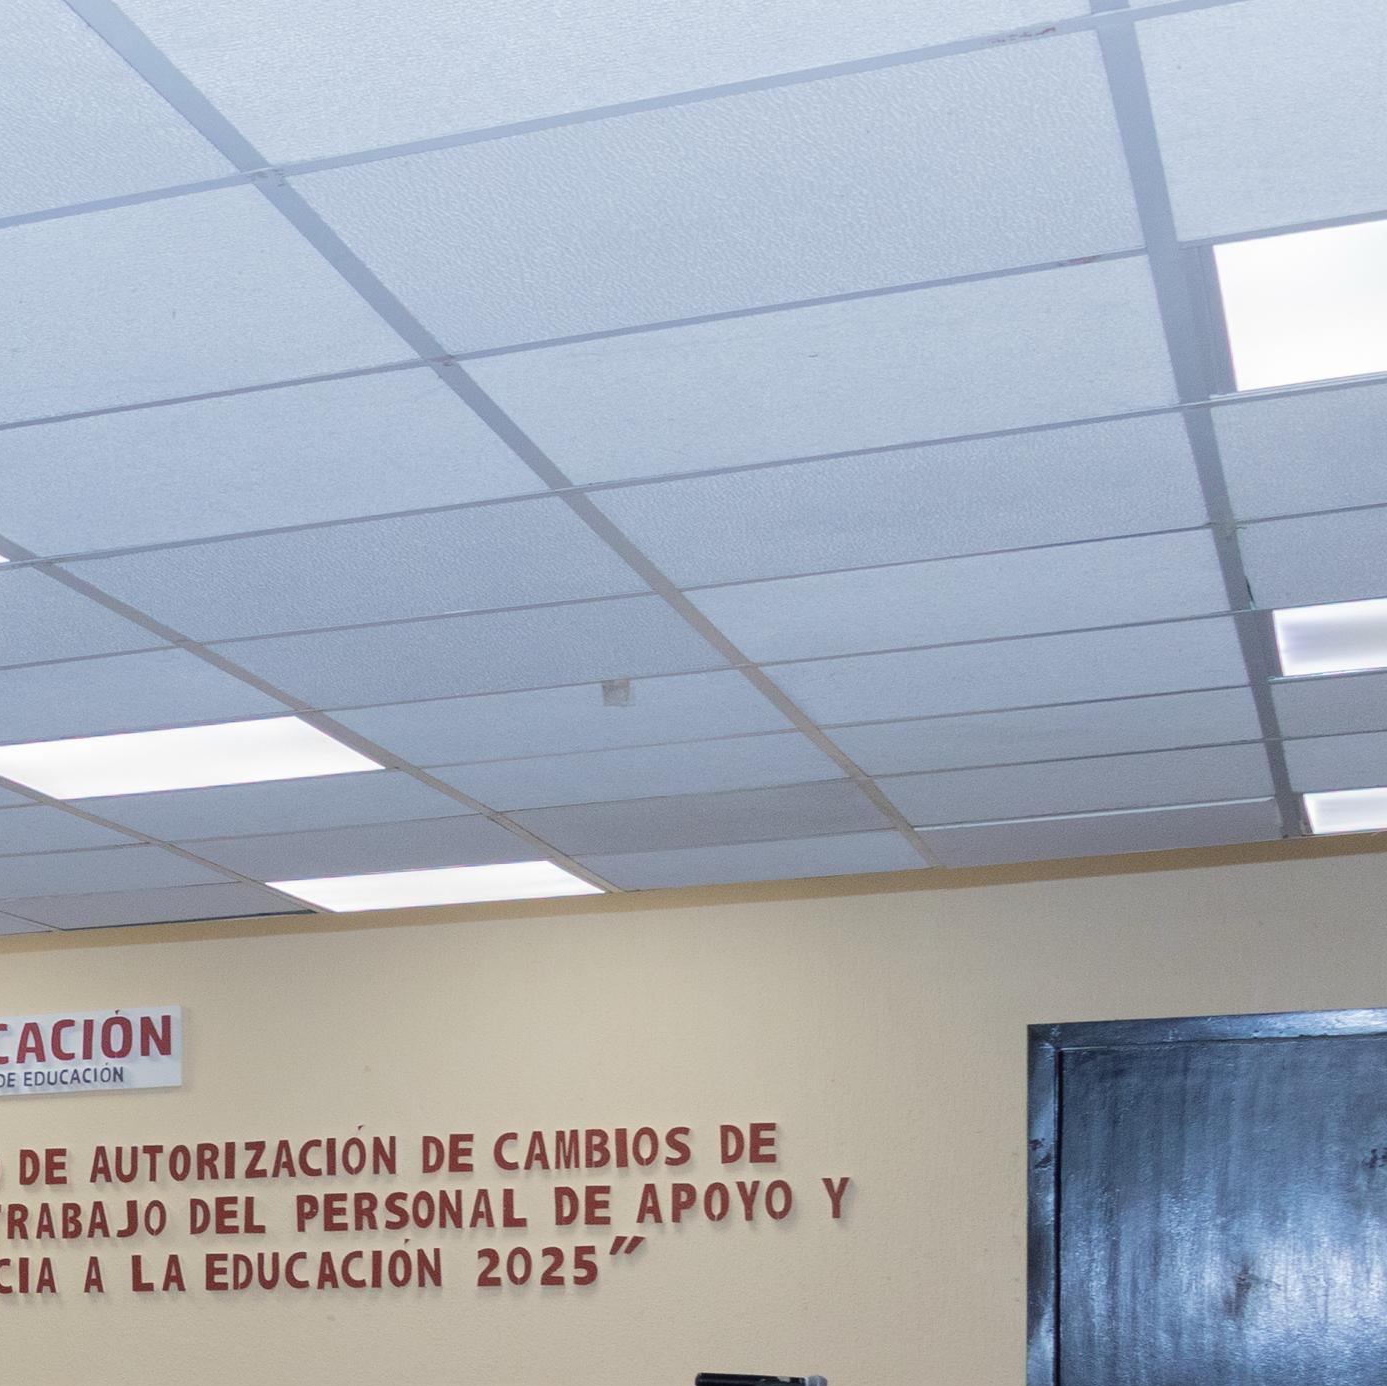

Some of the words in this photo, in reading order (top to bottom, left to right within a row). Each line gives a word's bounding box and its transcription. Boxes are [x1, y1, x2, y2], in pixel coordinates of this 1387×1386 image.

[23, 1061, 125, 1087] EDUCACIÓN
[18, 1148, 69, 1187] DE
[89, 1124, 397, 1185] AUTORIZACIÓN
[421, 1133, 475, 1174] DE
[492, 1126, 692, 1171] CAMBIOS
[719, 1122, 778, 1164] DE
[188, 1195, 267, 1236] DEL
[295, 1188, 528, 1233] PERSONAL
[554, 1185, 612, 1226] DE
[635, 1179, 794, 1225] APOYO
[821, 1177, 851, 1220] Y
[83, 1256, 105, 1294] A
[131, 1254, 187, 1292] LA
[204, 1238, 443, 1291] EDUCACIÓN
